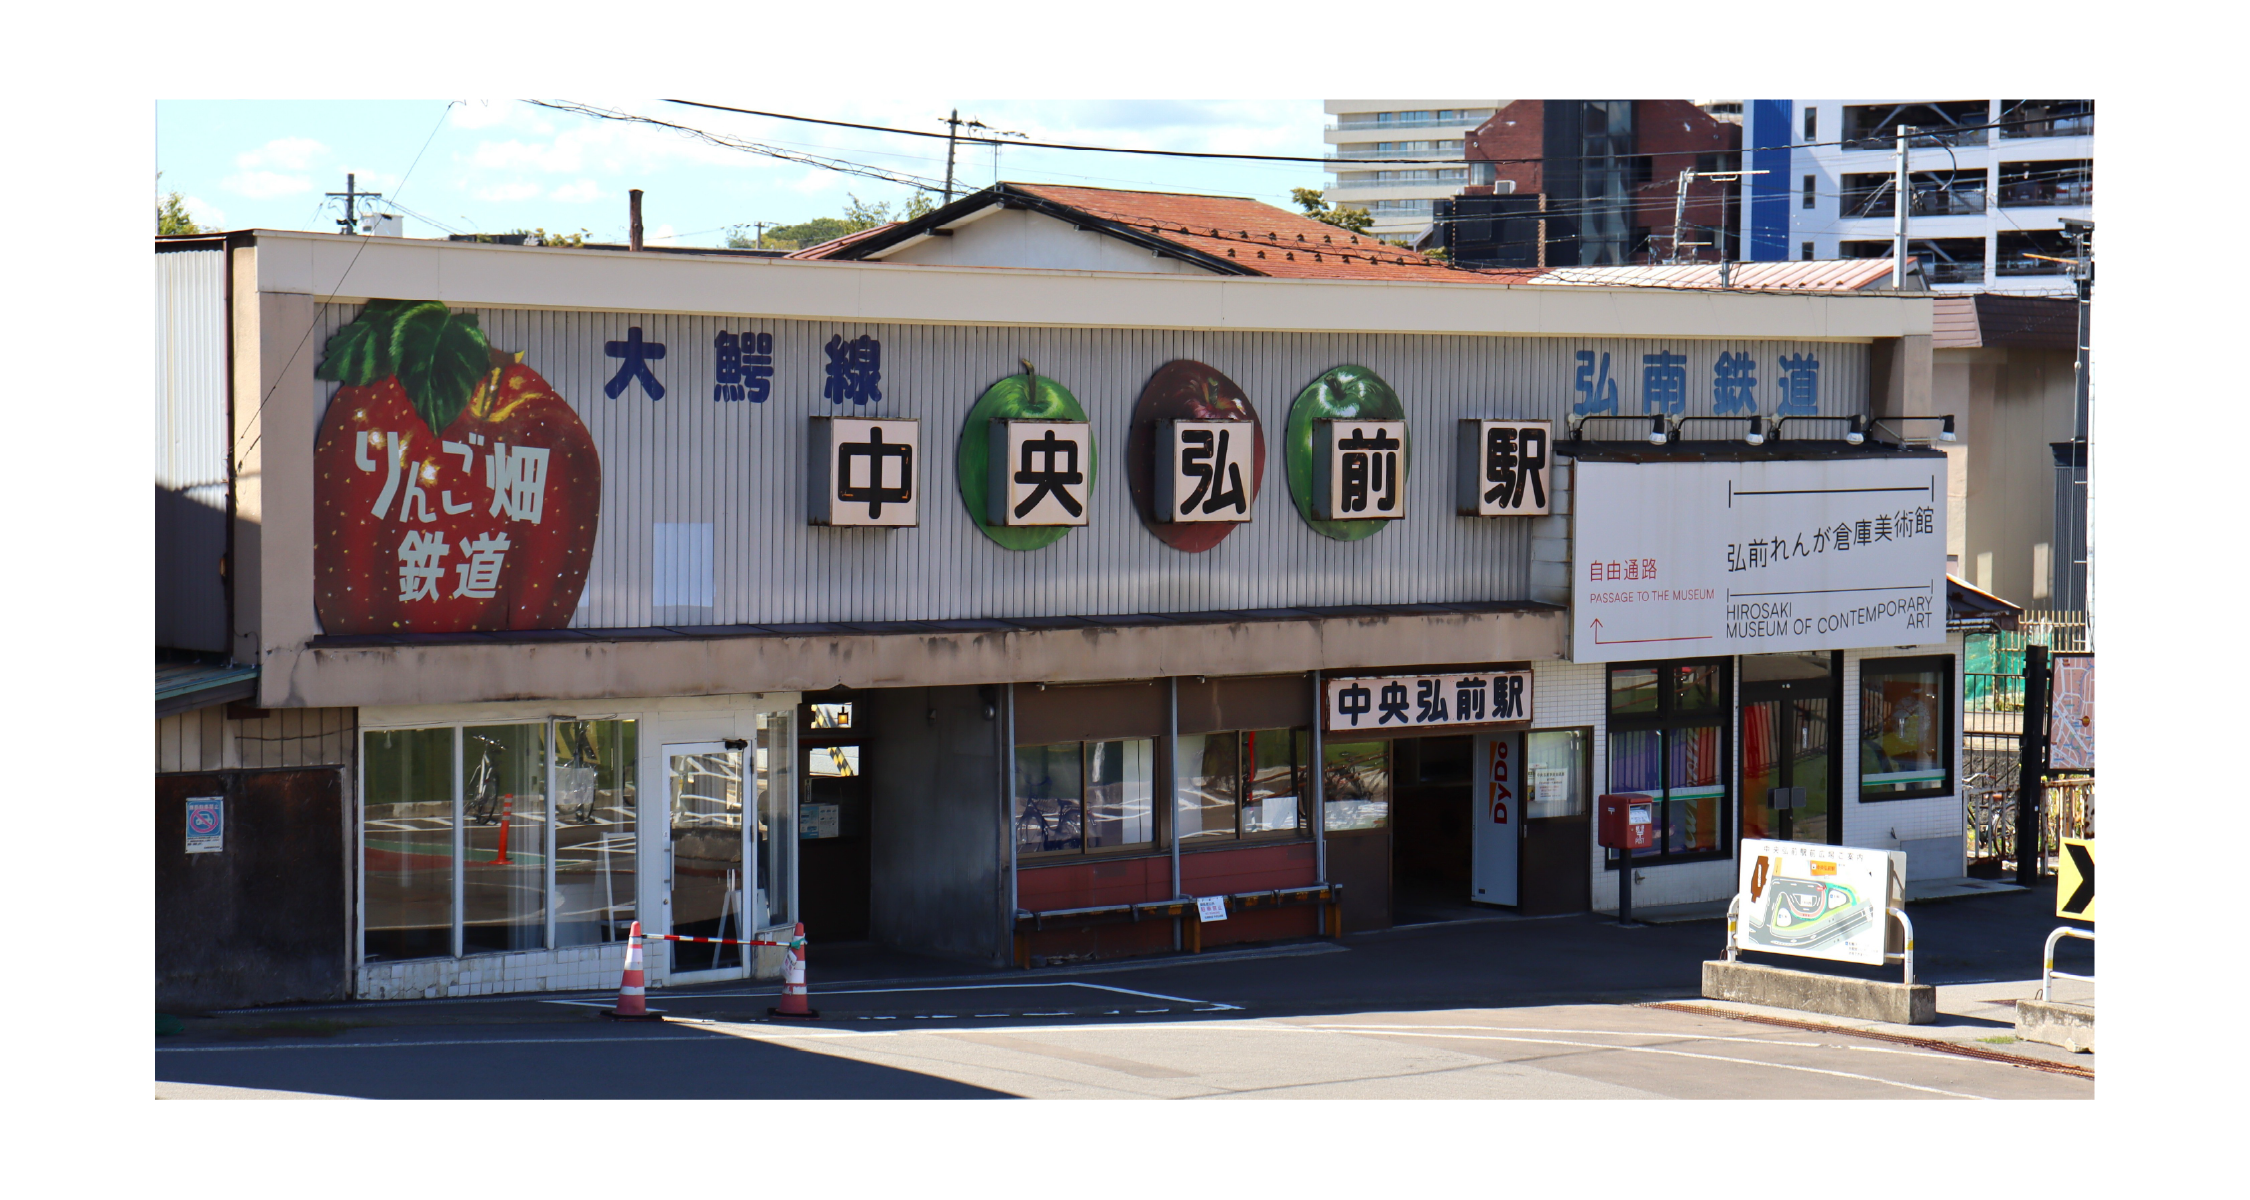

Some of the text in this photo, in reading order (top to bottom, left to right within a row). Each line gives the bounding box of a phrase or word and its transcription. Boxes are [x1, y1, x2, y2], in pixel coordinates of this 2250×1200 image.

[604, 326, 882, 406] 大鰐線
[1573, 349, 1820, 416] 弘南鉄道
[355, 431, 550, 525] りんご畑
[838, 426, 1547, 520] 中央弘前駅
[397, 530, 512, 602] 鉄道
[1727, 505, 1934, 573] 弘前れんが倉庫美術館
[1589, 557, 1658, 582] 自由通路
[1589, 588, 1715, 604] PASSAGE TO THE MUSEUM
[1726, 601, 1792, 621] HIROSAKI
[1726, 596, 1933, 639] MUSEUM OF CONTEMPORARY
[1906, 612, 1933, 630] ART
[1338, 675, 1524, 727] 中央弘前駅
